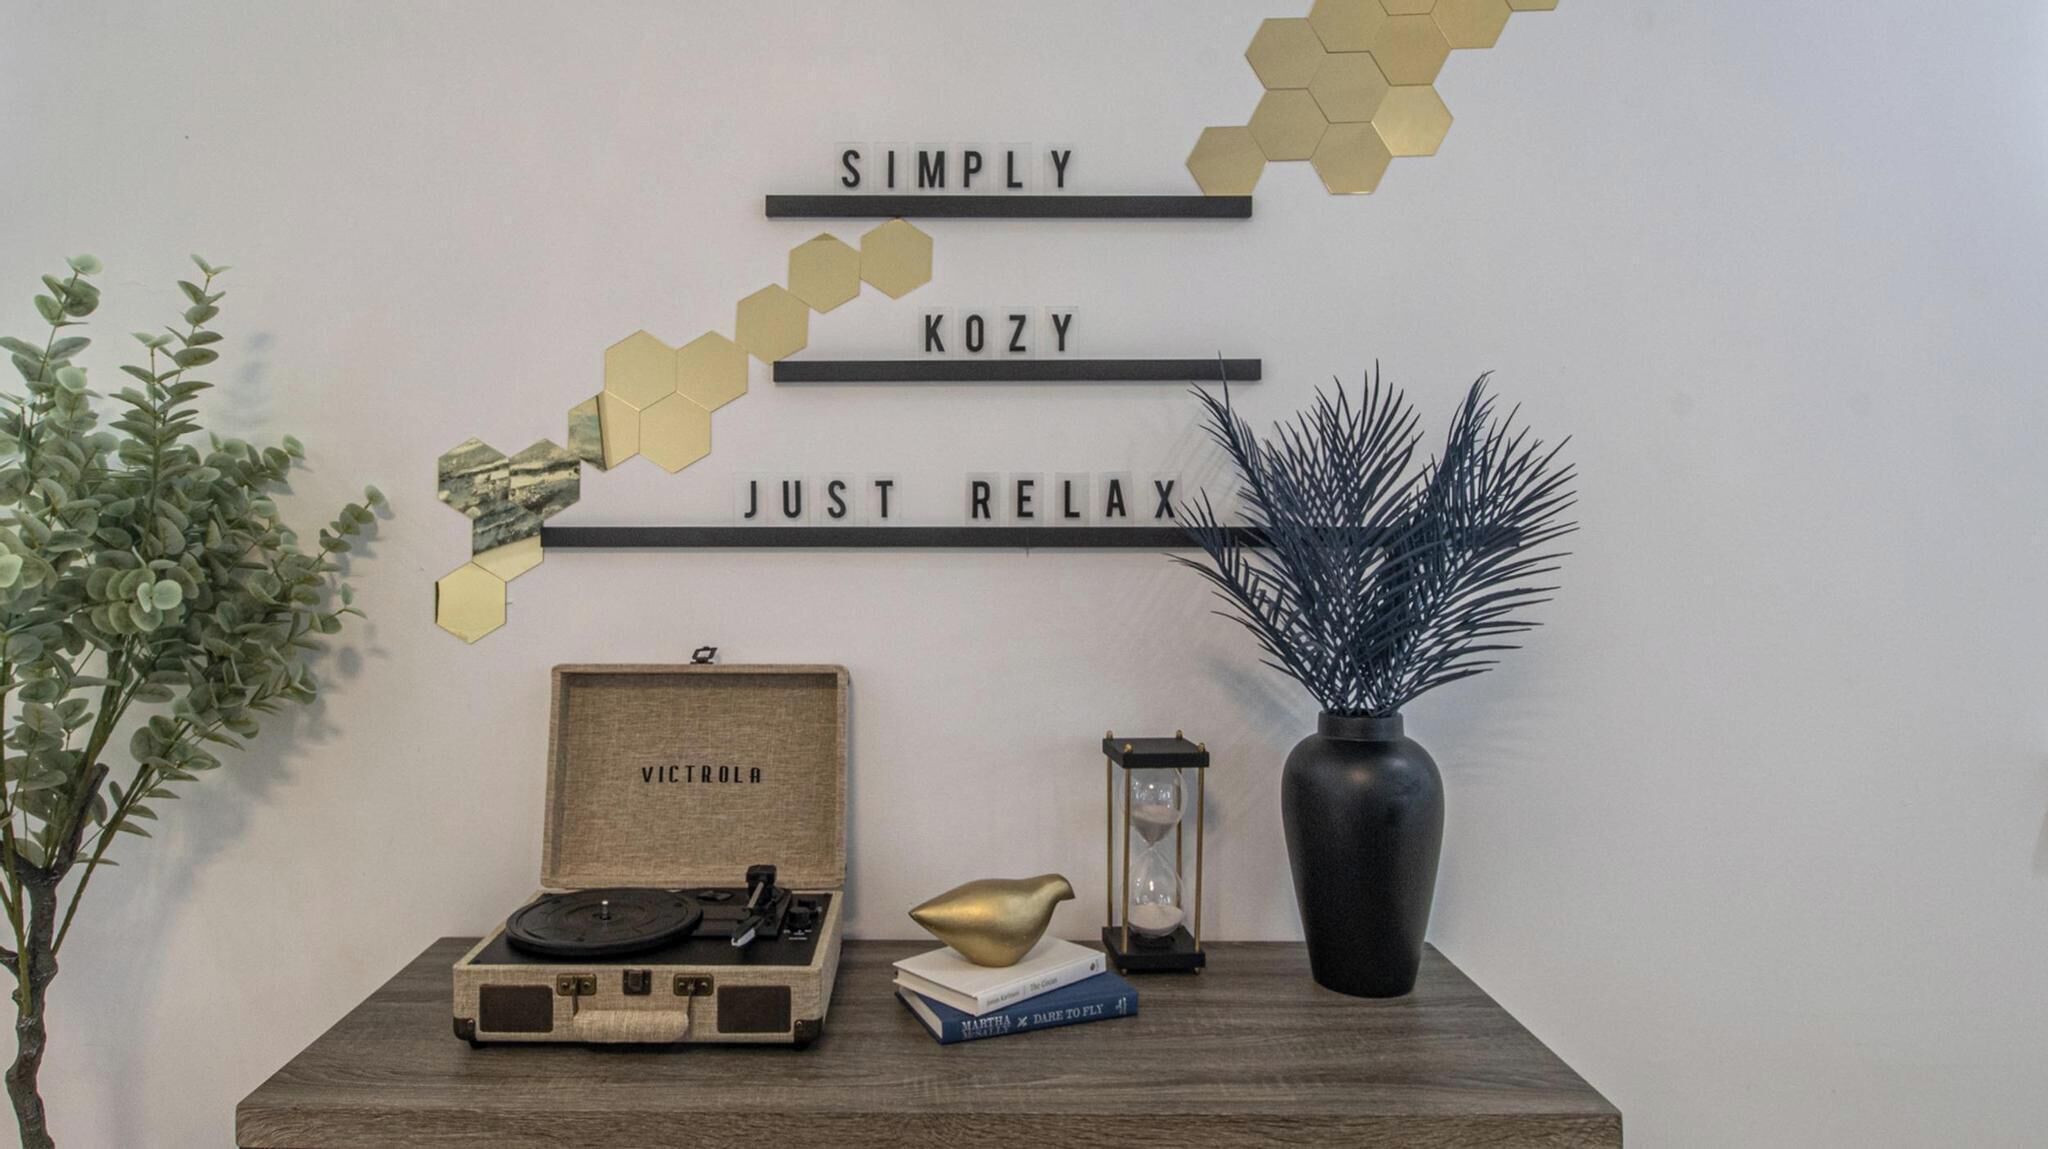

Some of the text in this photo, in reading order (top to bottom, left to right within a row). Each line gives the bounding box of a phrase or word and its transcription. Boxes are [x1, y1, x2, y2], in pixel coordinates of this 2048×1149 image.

[841, 149, 1072, 189] SIMPLY
[925, 314, 1072, 353] KOZY
[744, 479, 1177, 520] JUST RELAX
[641, 765, 762, 784] VICTROLA
[961, 1003, 1105, 1031] MARTHA DARE TO FLY
